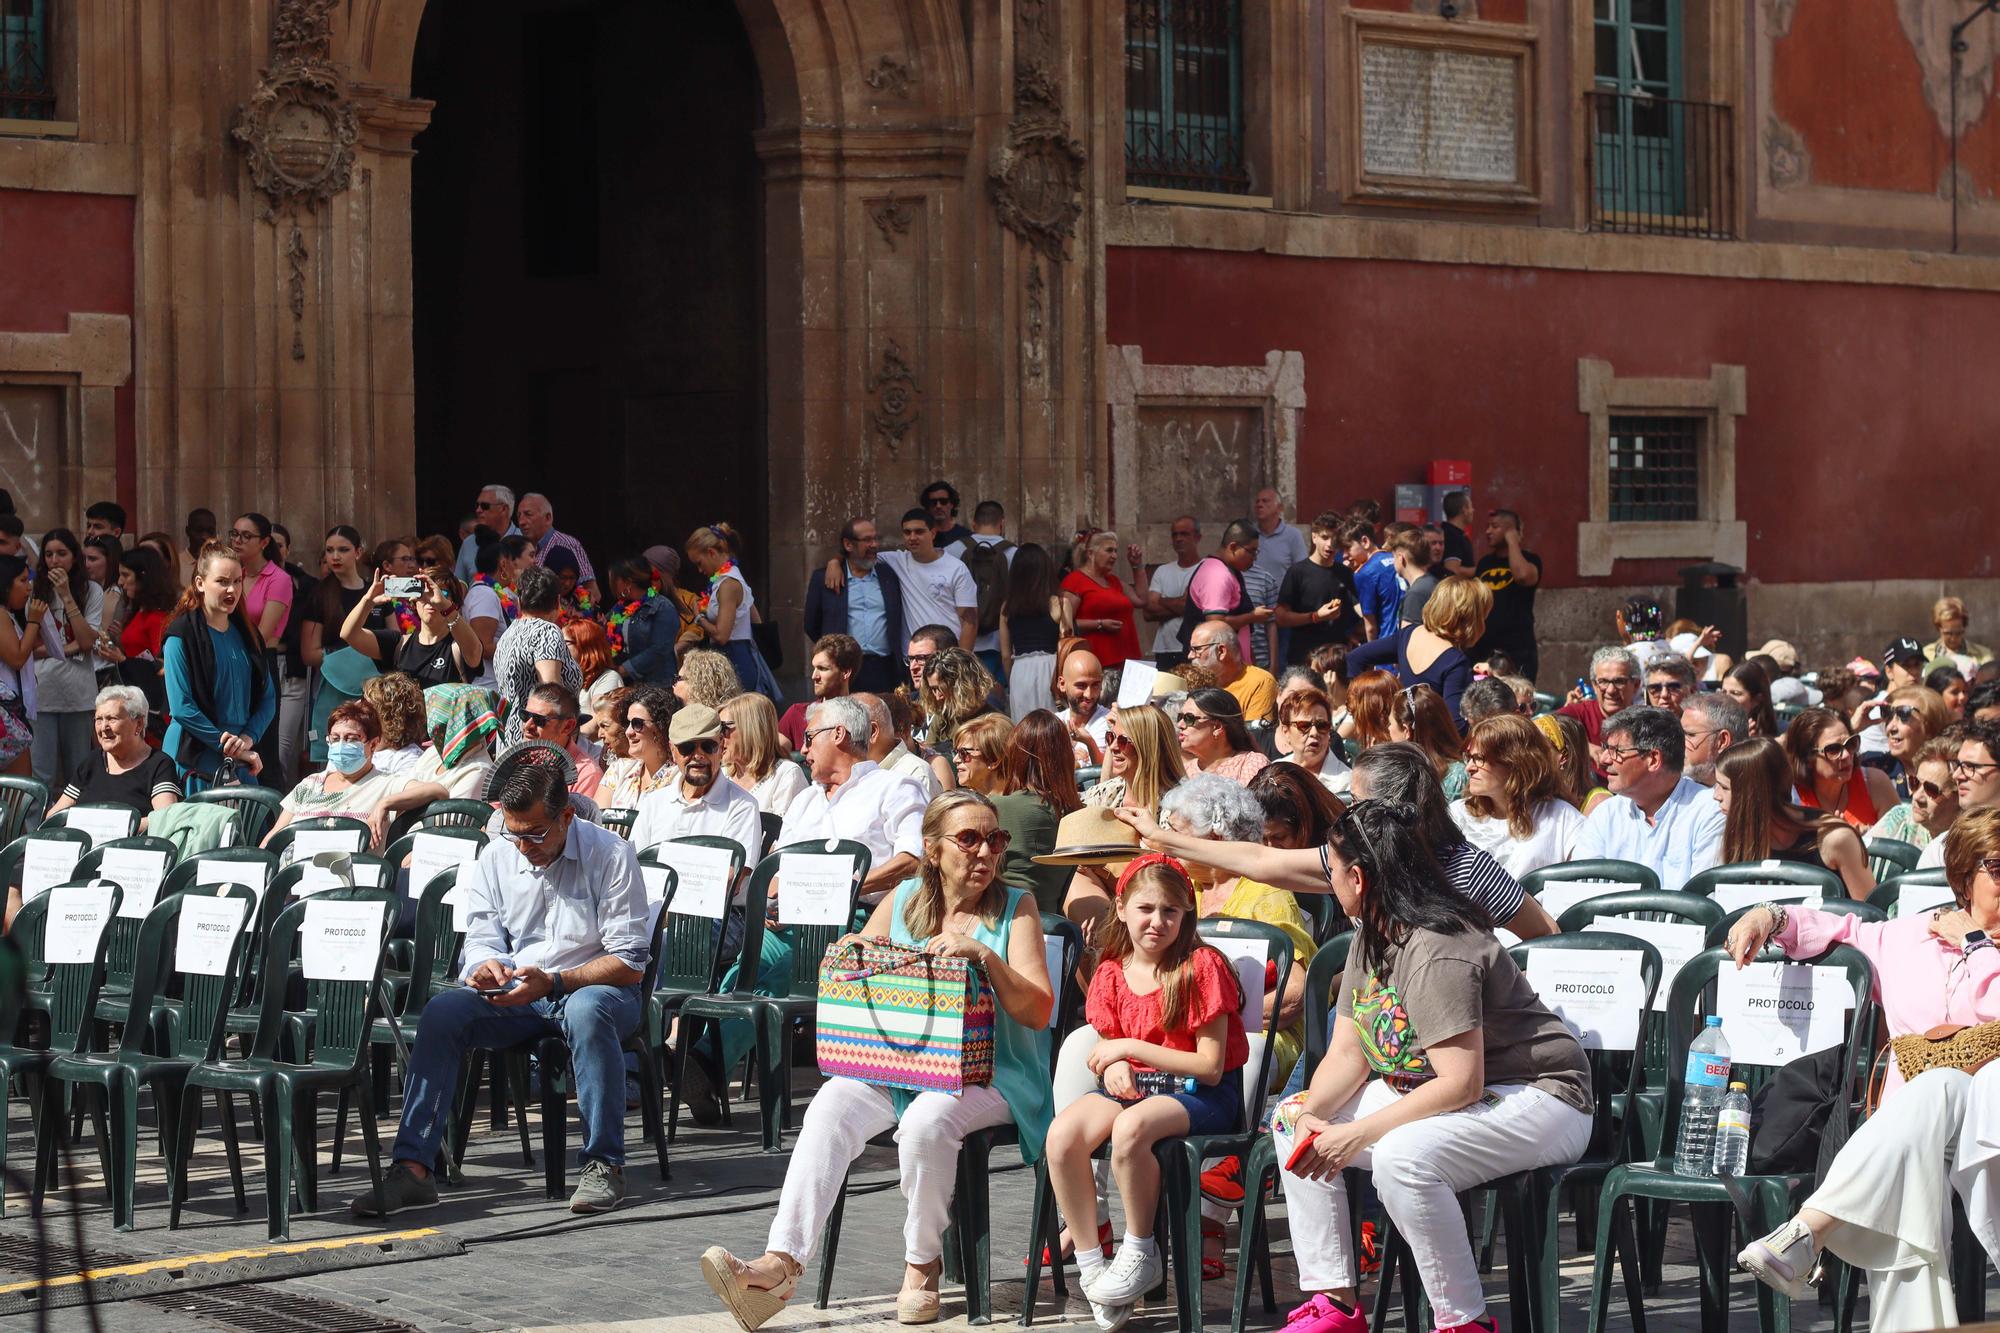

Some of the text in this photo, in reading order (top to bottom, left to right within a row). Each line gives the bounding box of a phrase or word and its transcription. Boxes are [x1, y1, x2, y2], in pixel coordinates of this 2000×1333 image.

[64, 913, 98, 922] PROTOCOLO
[196, 922, 231, 933] PROTOCOLO
[324, 927, 367, 938] PROTOCOLO
[1554, 983, 1615, 995] PROTOCOLO
[1747, 998, 1815, 1011] PROTOCOLO
